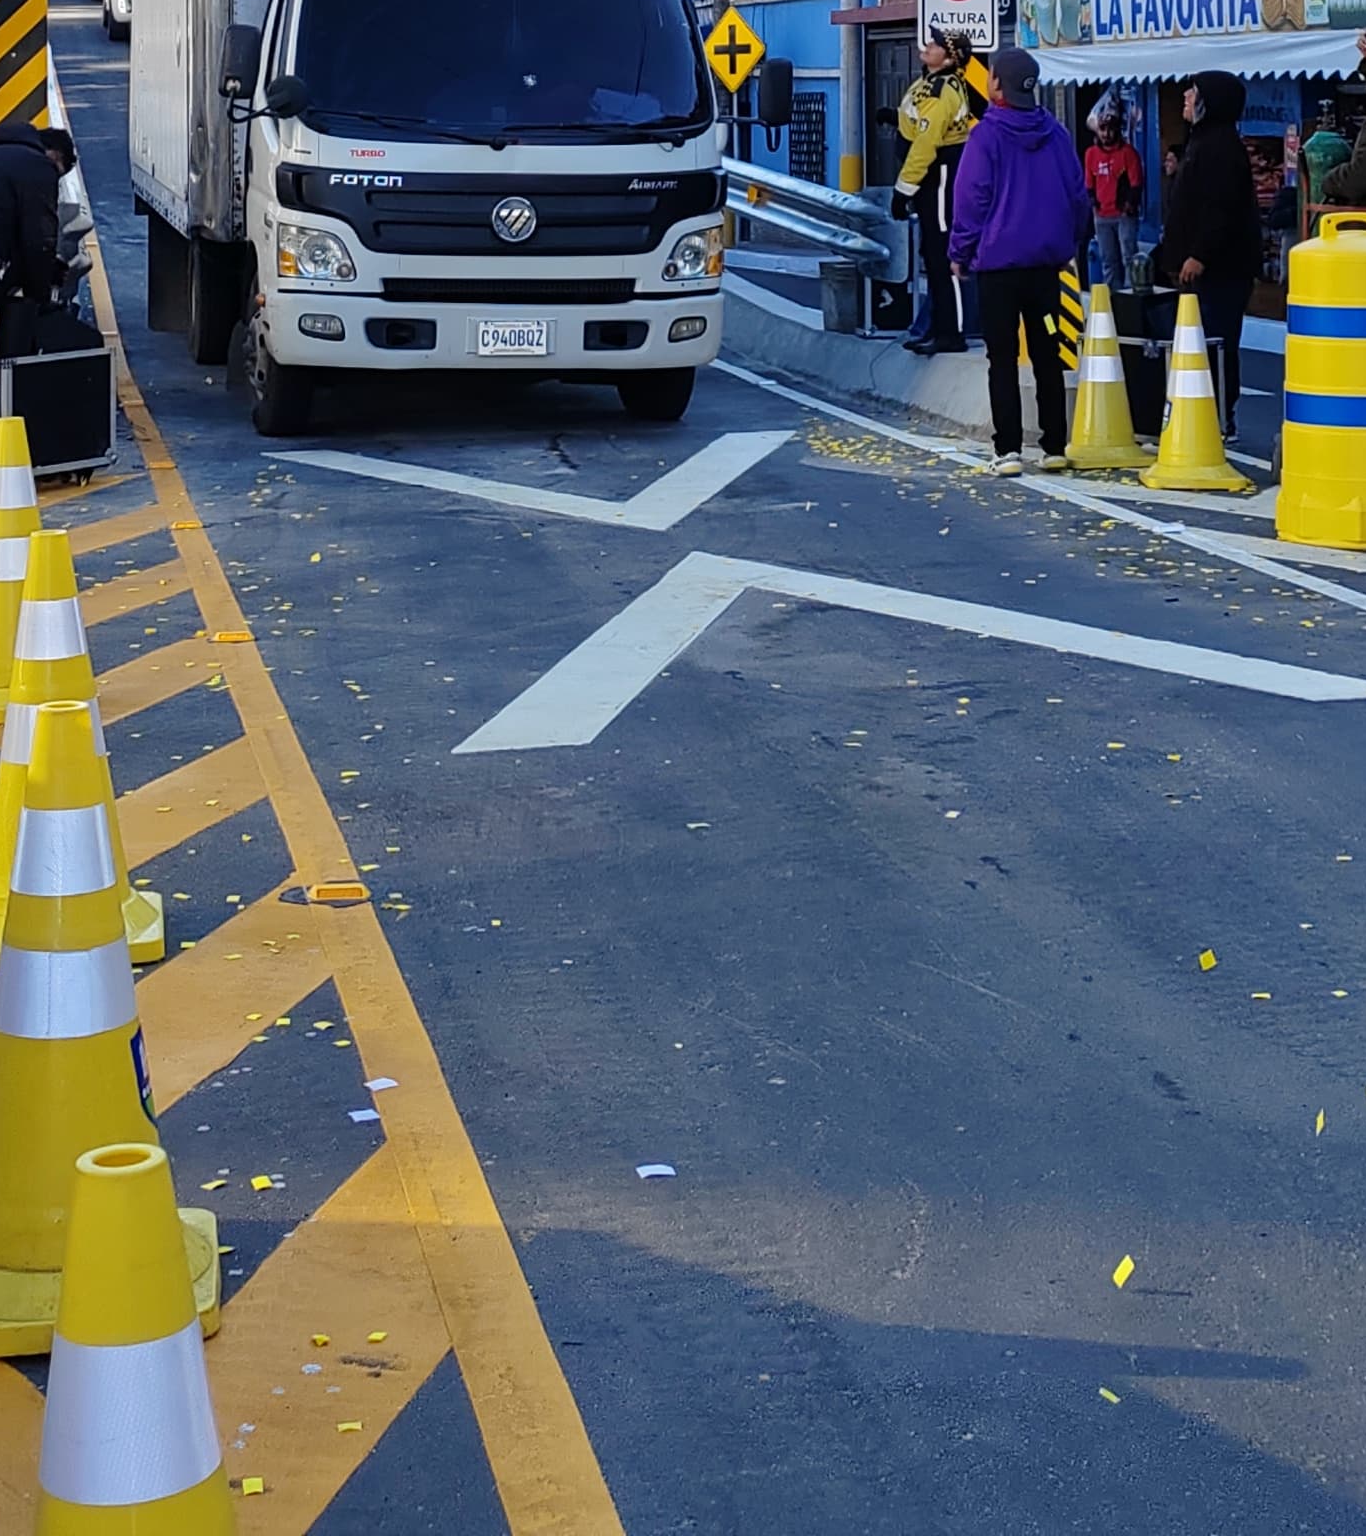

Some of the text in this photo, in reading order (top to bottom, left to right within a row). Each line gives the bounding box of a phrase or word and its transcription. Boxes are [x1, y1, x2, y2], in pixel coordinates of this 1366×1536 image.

[930, 11, 988, 25] ALTURA
[349, 149, 386, 158] TURBO
[329, 173, 403, 187] FOTON
[481, 329, 544, 347] C940BQZ
